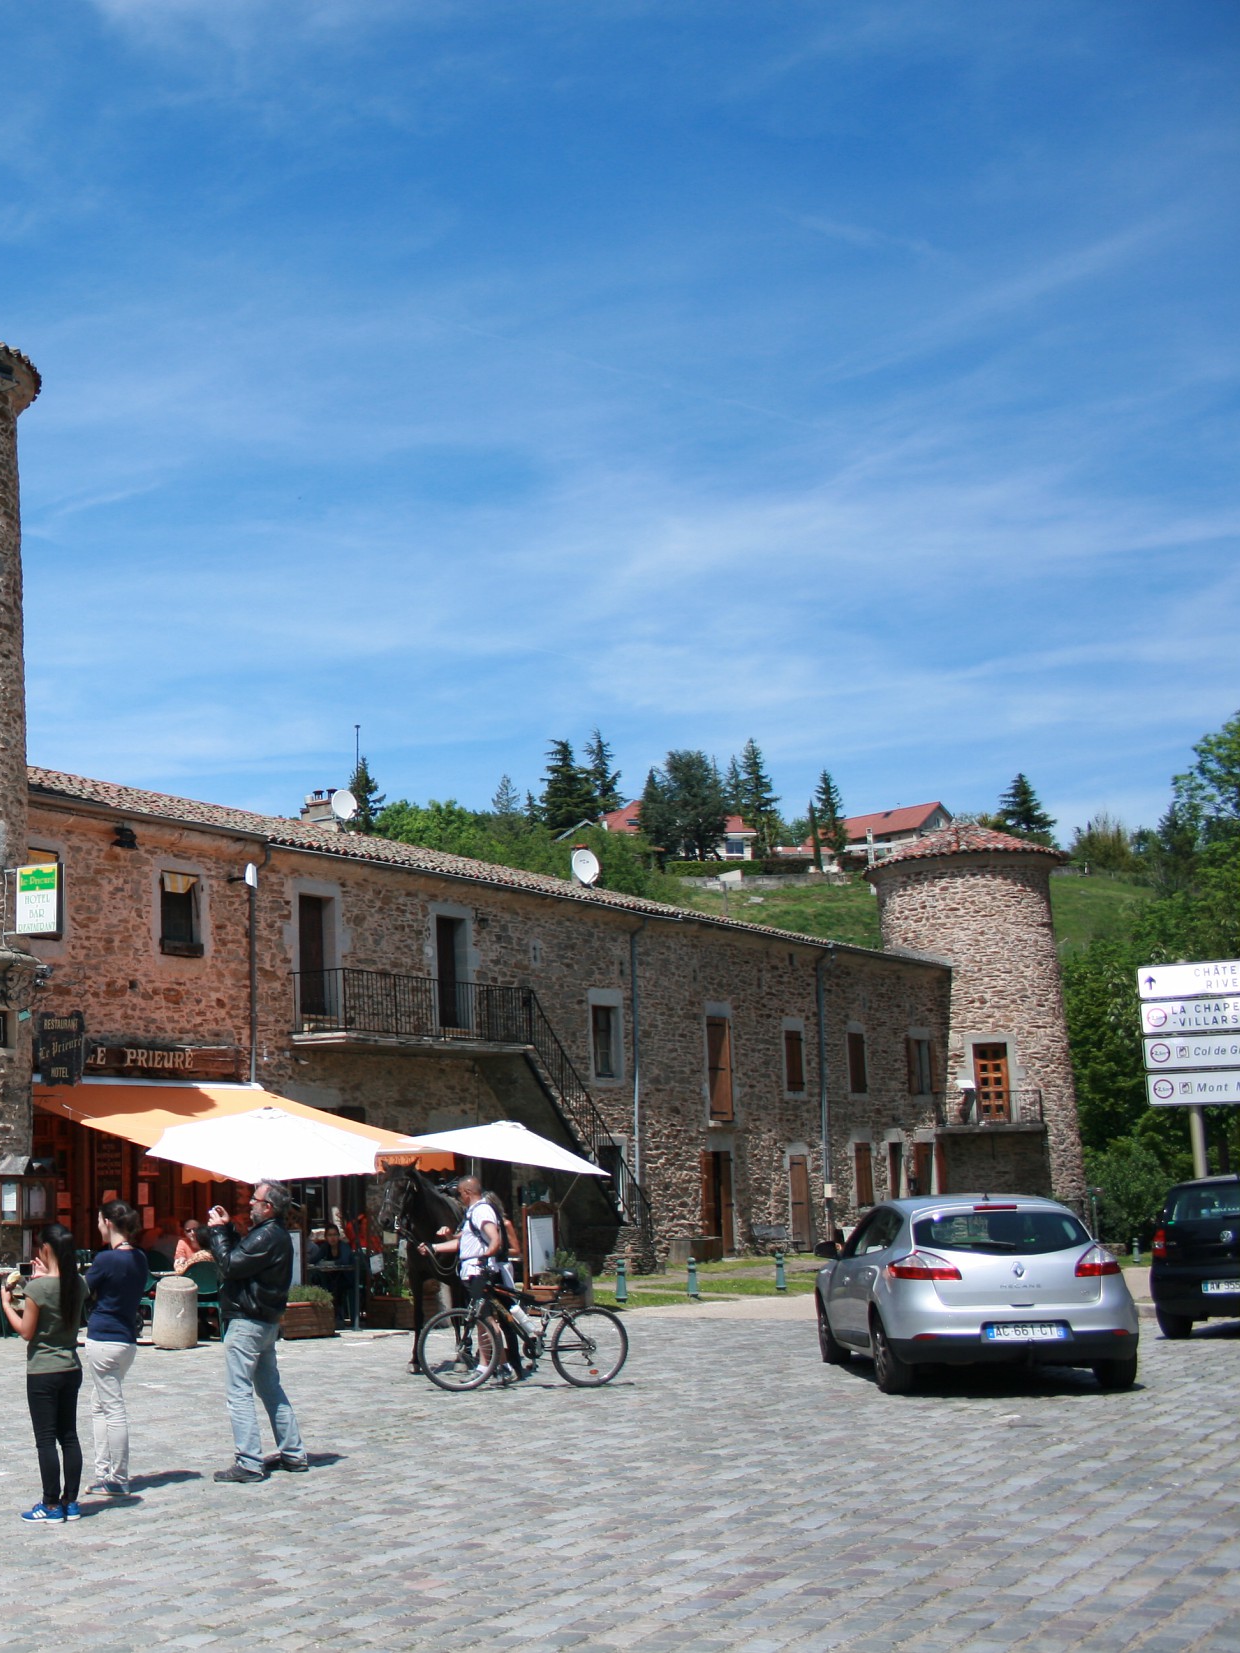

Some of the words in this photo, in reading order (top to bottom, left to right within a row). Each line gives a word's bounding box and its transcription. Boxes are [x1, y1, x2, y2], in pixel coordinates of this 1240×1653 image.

[24, 894, 50, 905] HOTEL
[29, 909, 45, 919] BAR
[1171, 1006, 1186, 1015] LA
[44, 1018, 79, 1030] RESTAURANT
[1194, 1047, 1211, 1056] Col
[1214, 1046, 1227, 1055] de
[1230, 1045, 1240, 1055] G
[50, 1066, 69, 1078] HOTEL
[1196, 1082, 1228, 1092] Mont
